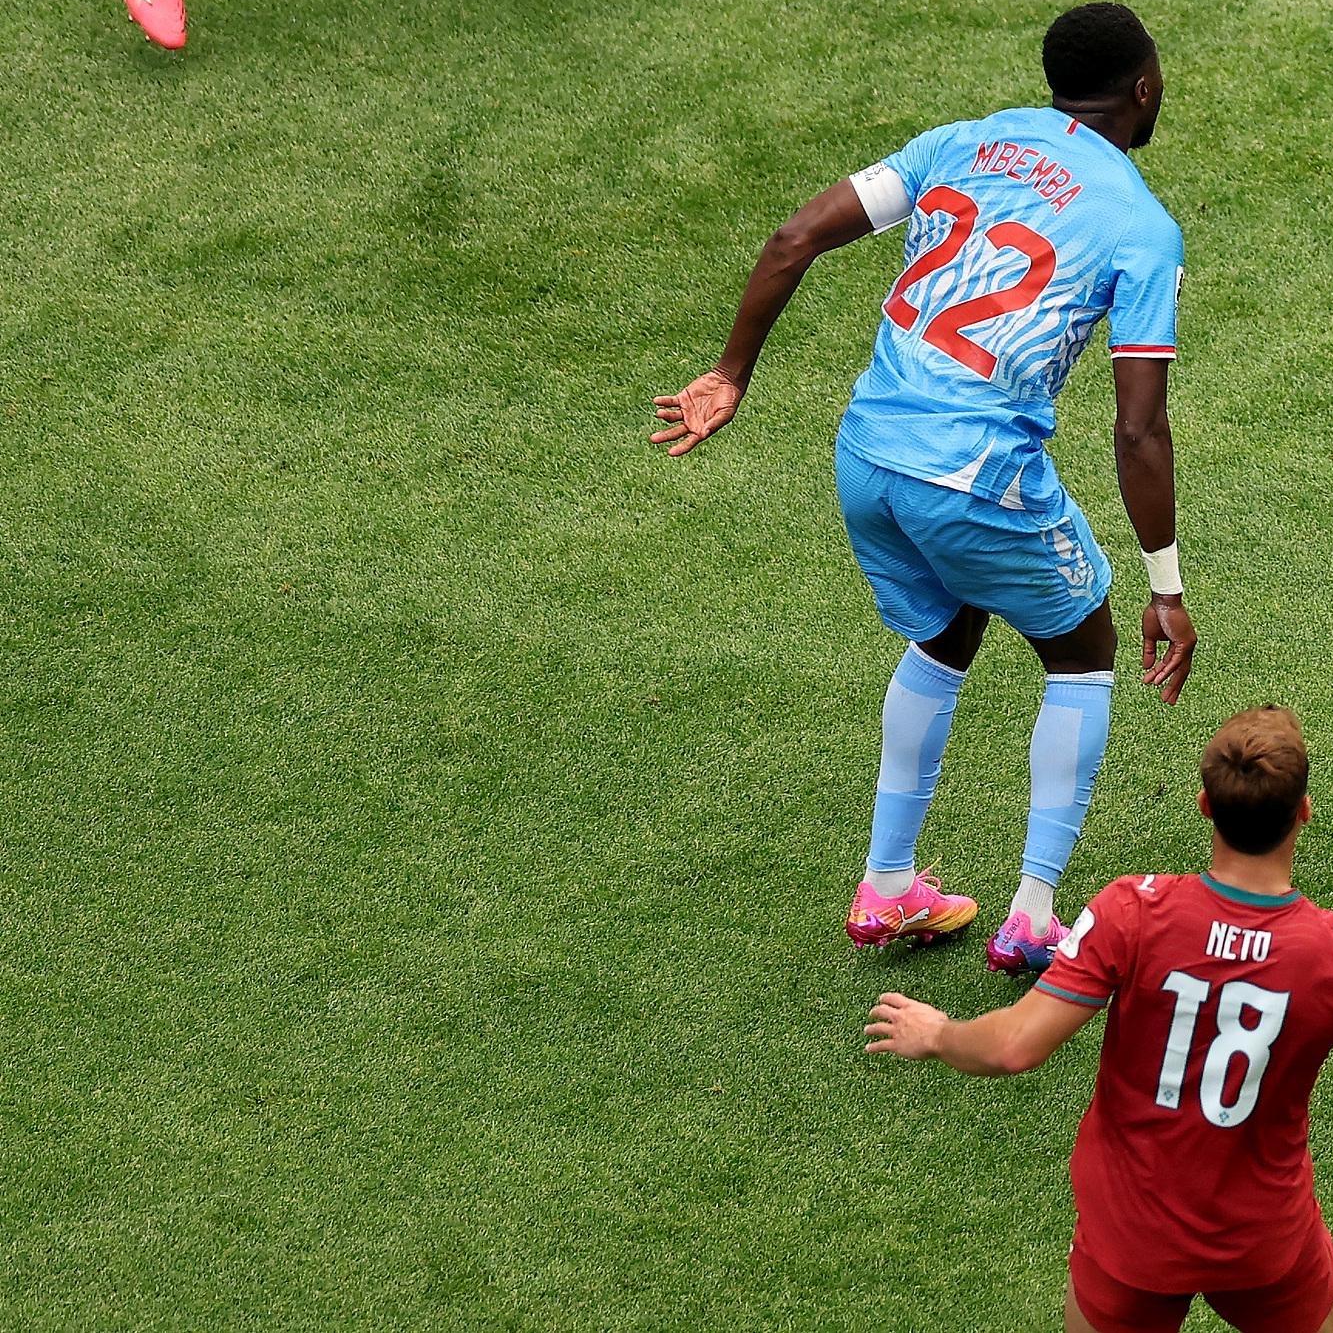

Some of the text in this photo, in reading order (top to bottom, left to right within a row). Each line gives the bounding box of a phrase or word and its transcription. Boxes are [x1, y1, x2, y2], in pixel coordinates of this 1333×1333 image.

[968, 140, 1084, 216] MBEMBA
[881, 184, 1058, 382] 22
[1204, 919, 1273, 963] NETO
[1155, 969, 1291, 1129] 18
